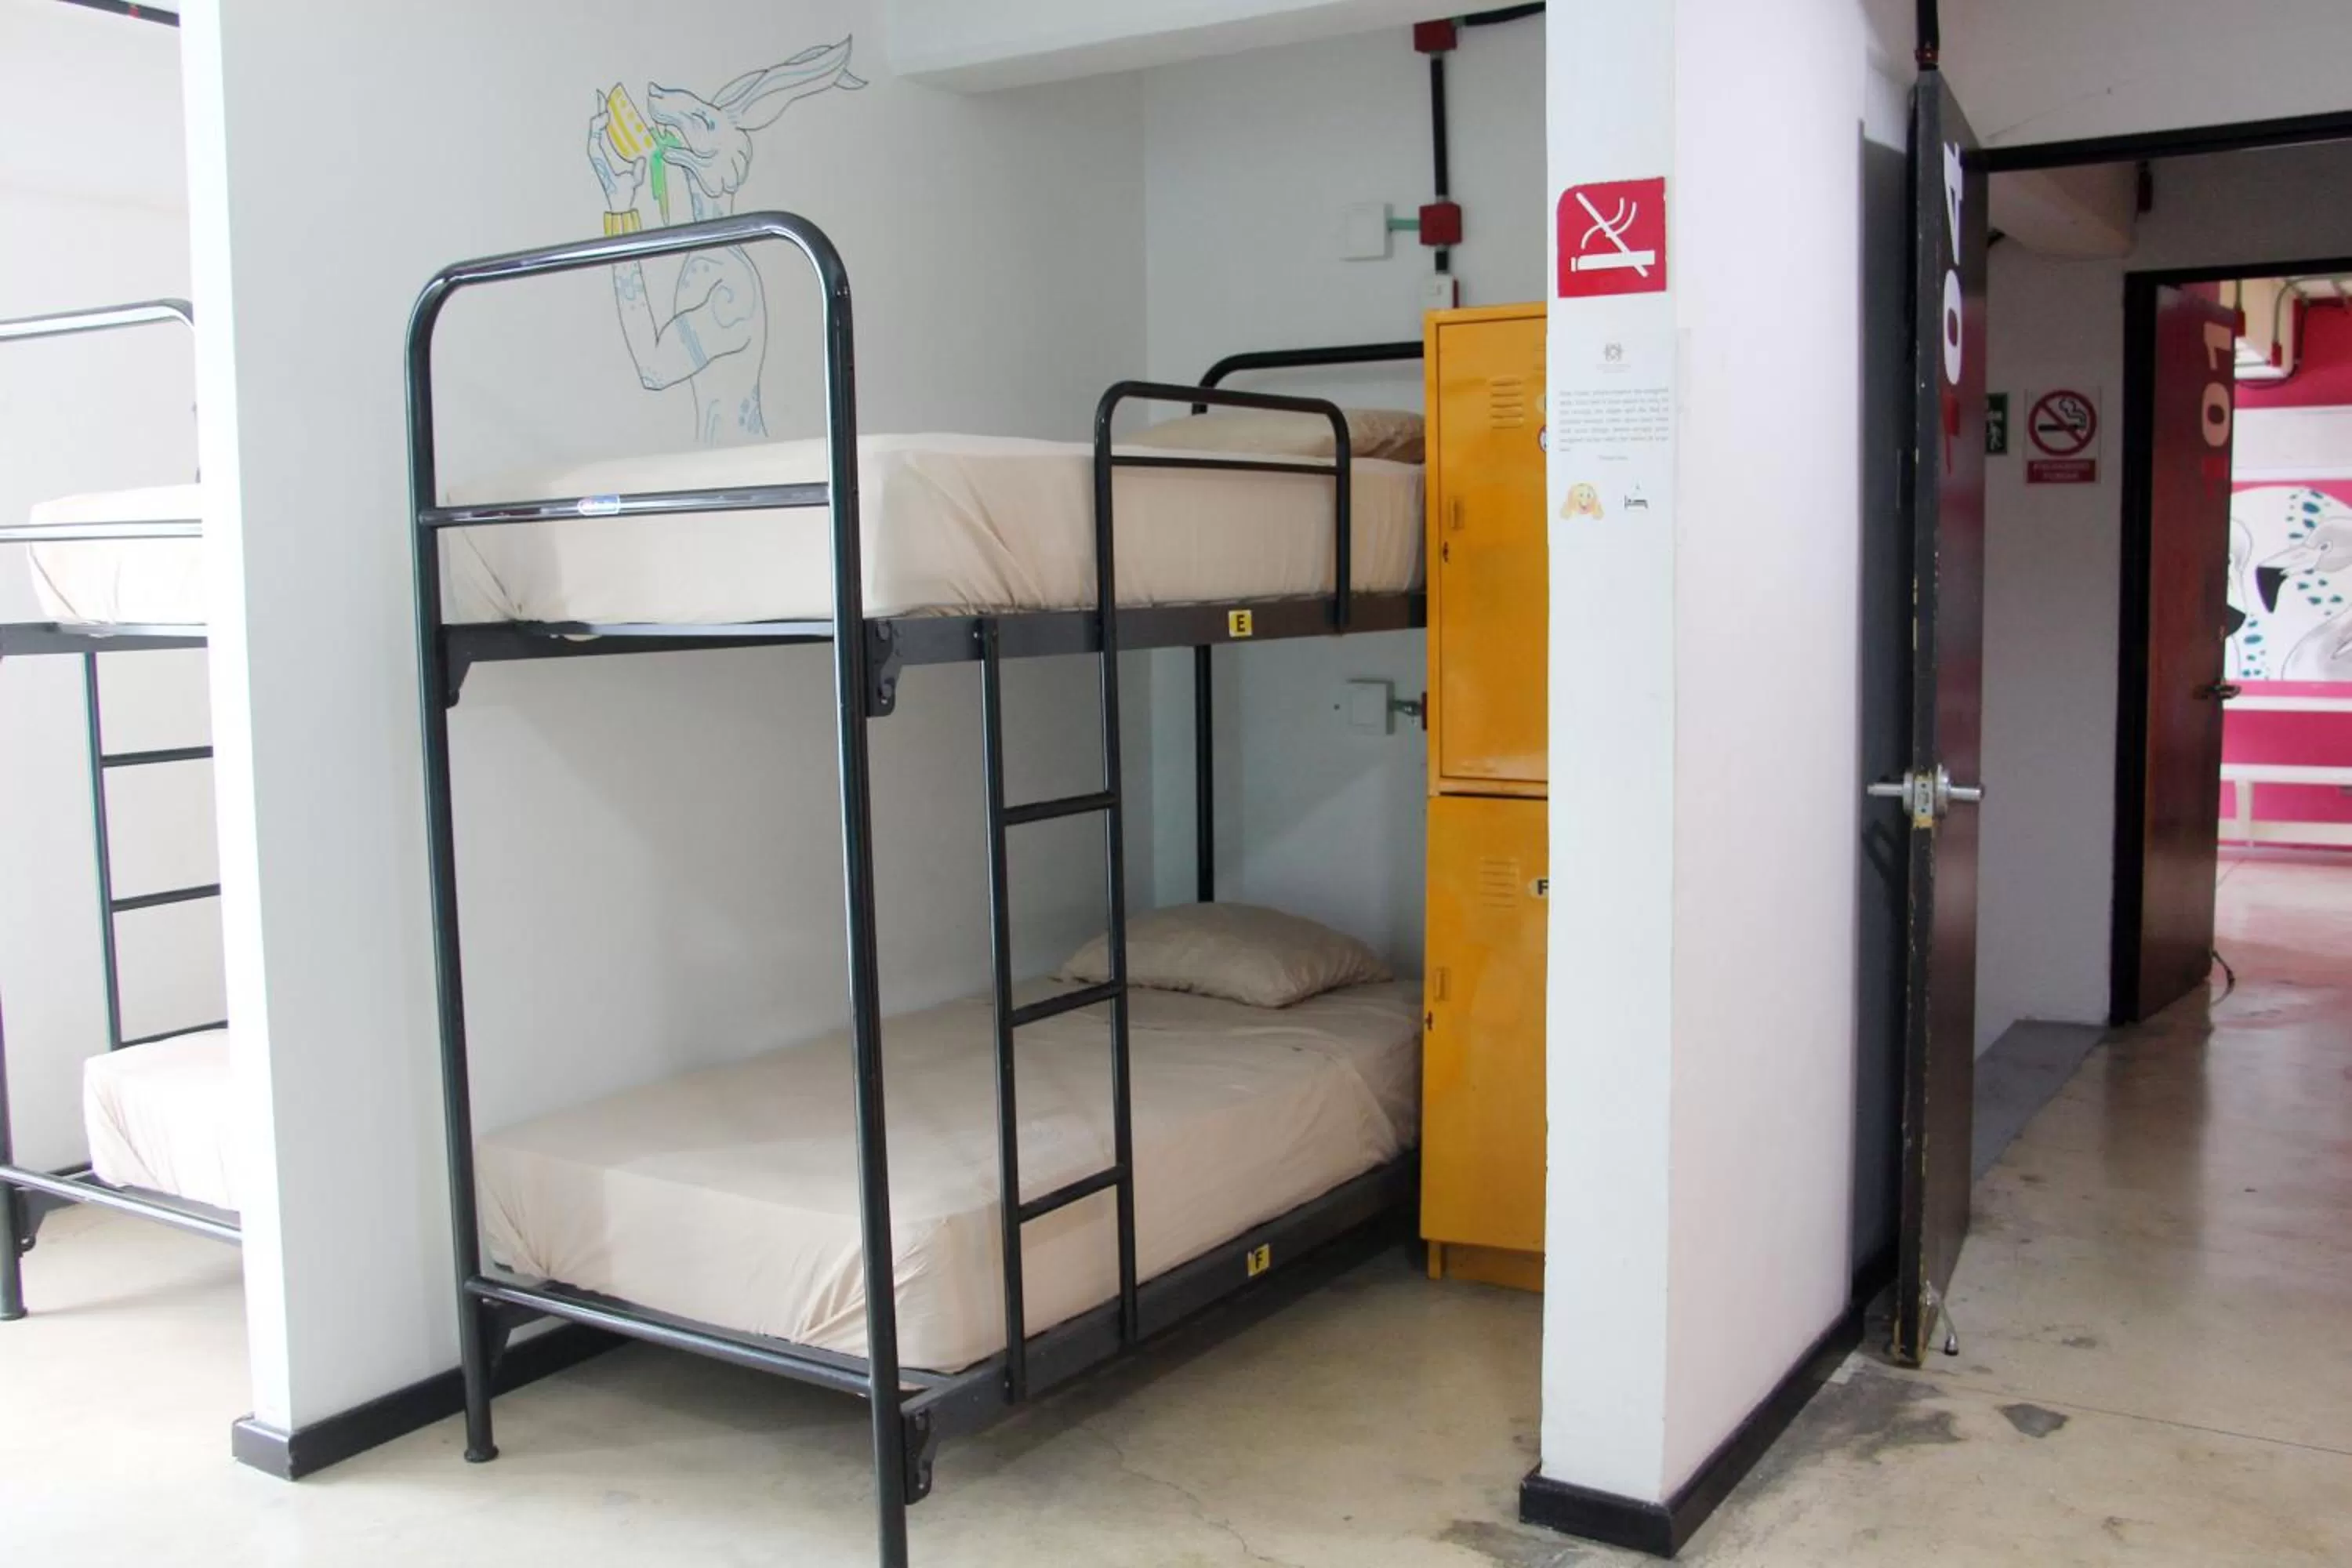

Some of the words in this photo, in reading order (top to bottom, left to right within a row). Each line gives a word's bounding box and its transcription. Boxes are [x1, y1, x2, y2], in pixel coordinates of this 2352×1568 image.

[1941, 142, 1962, 477] 104
[2201, 321, 2232, 500] 101
[1236, 614, 1246, 633] E
[1537, 879, 1549, 895] F
[1255, 1250, 1263, 1269] F
